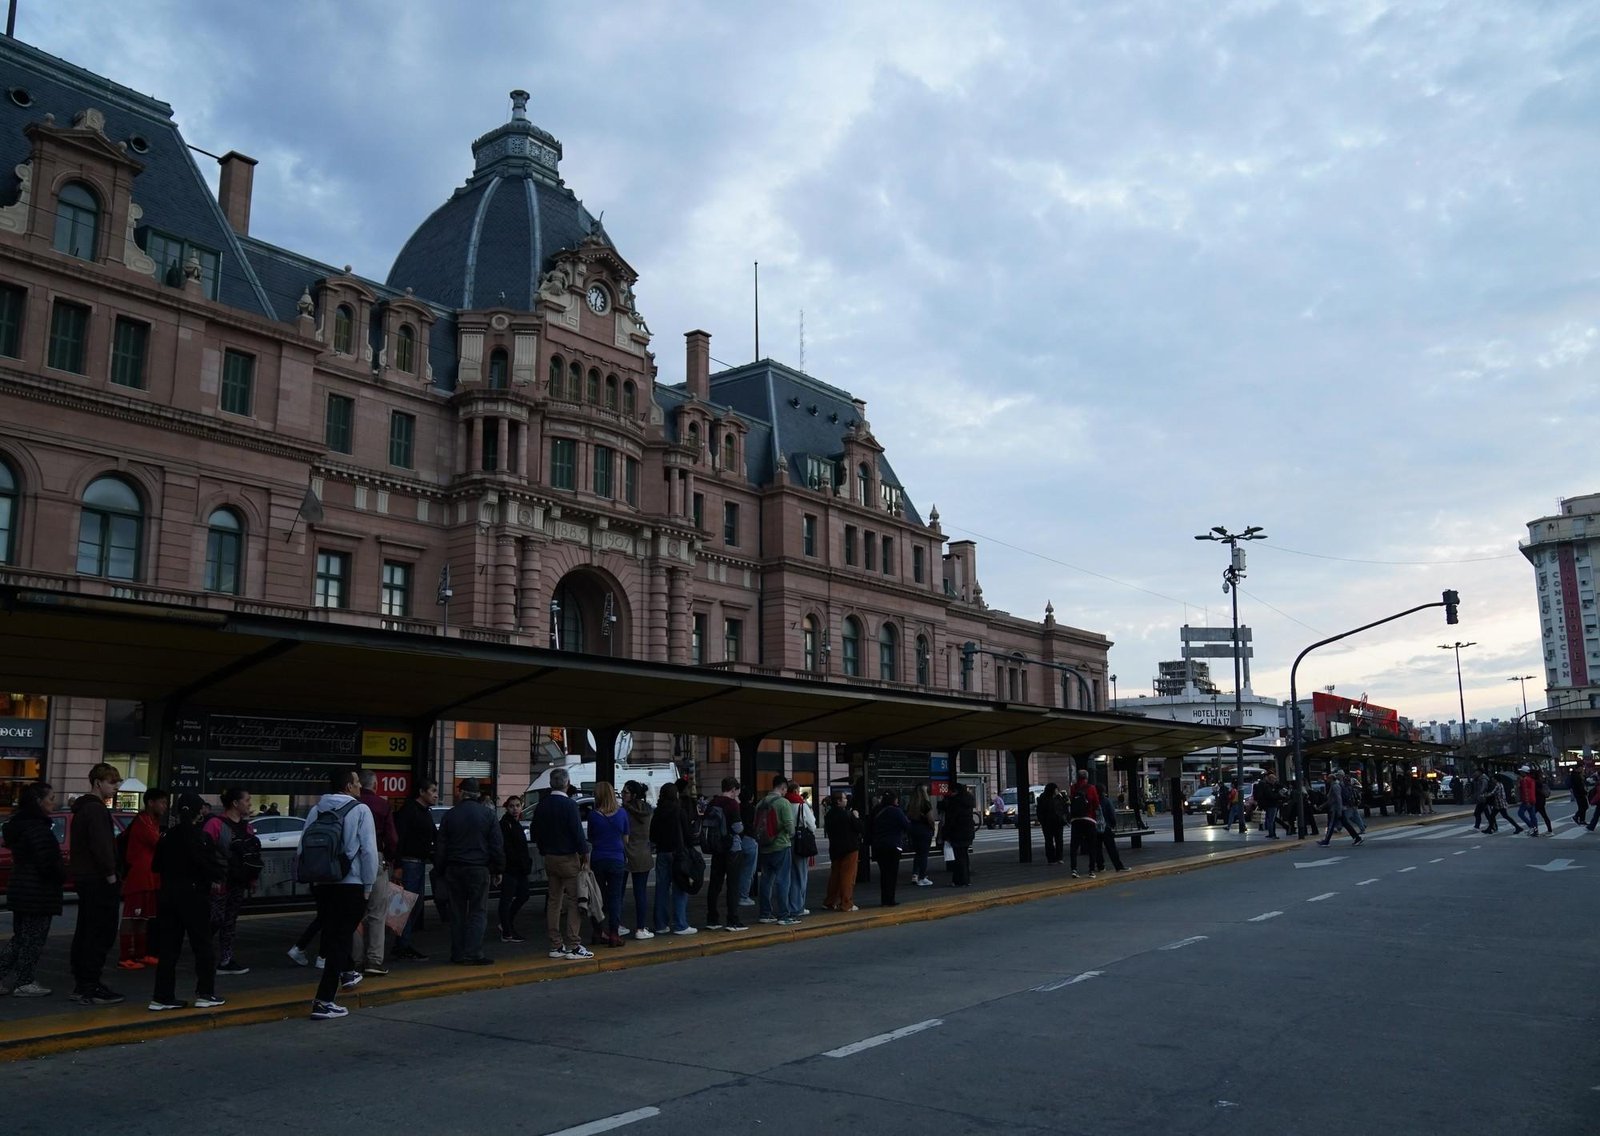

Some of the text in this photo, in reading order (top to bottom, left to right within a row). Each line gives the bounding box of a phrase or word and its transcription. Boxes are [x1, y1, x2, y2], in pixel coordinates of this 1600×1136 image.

[556, 522, 587, 541] 1885
[604, 532, 631, 549] 1907
[1193, 709, 1215, 718] HOTEL
[389, 737, 408, 752] 98
[381, 777, 407, 792] 100
